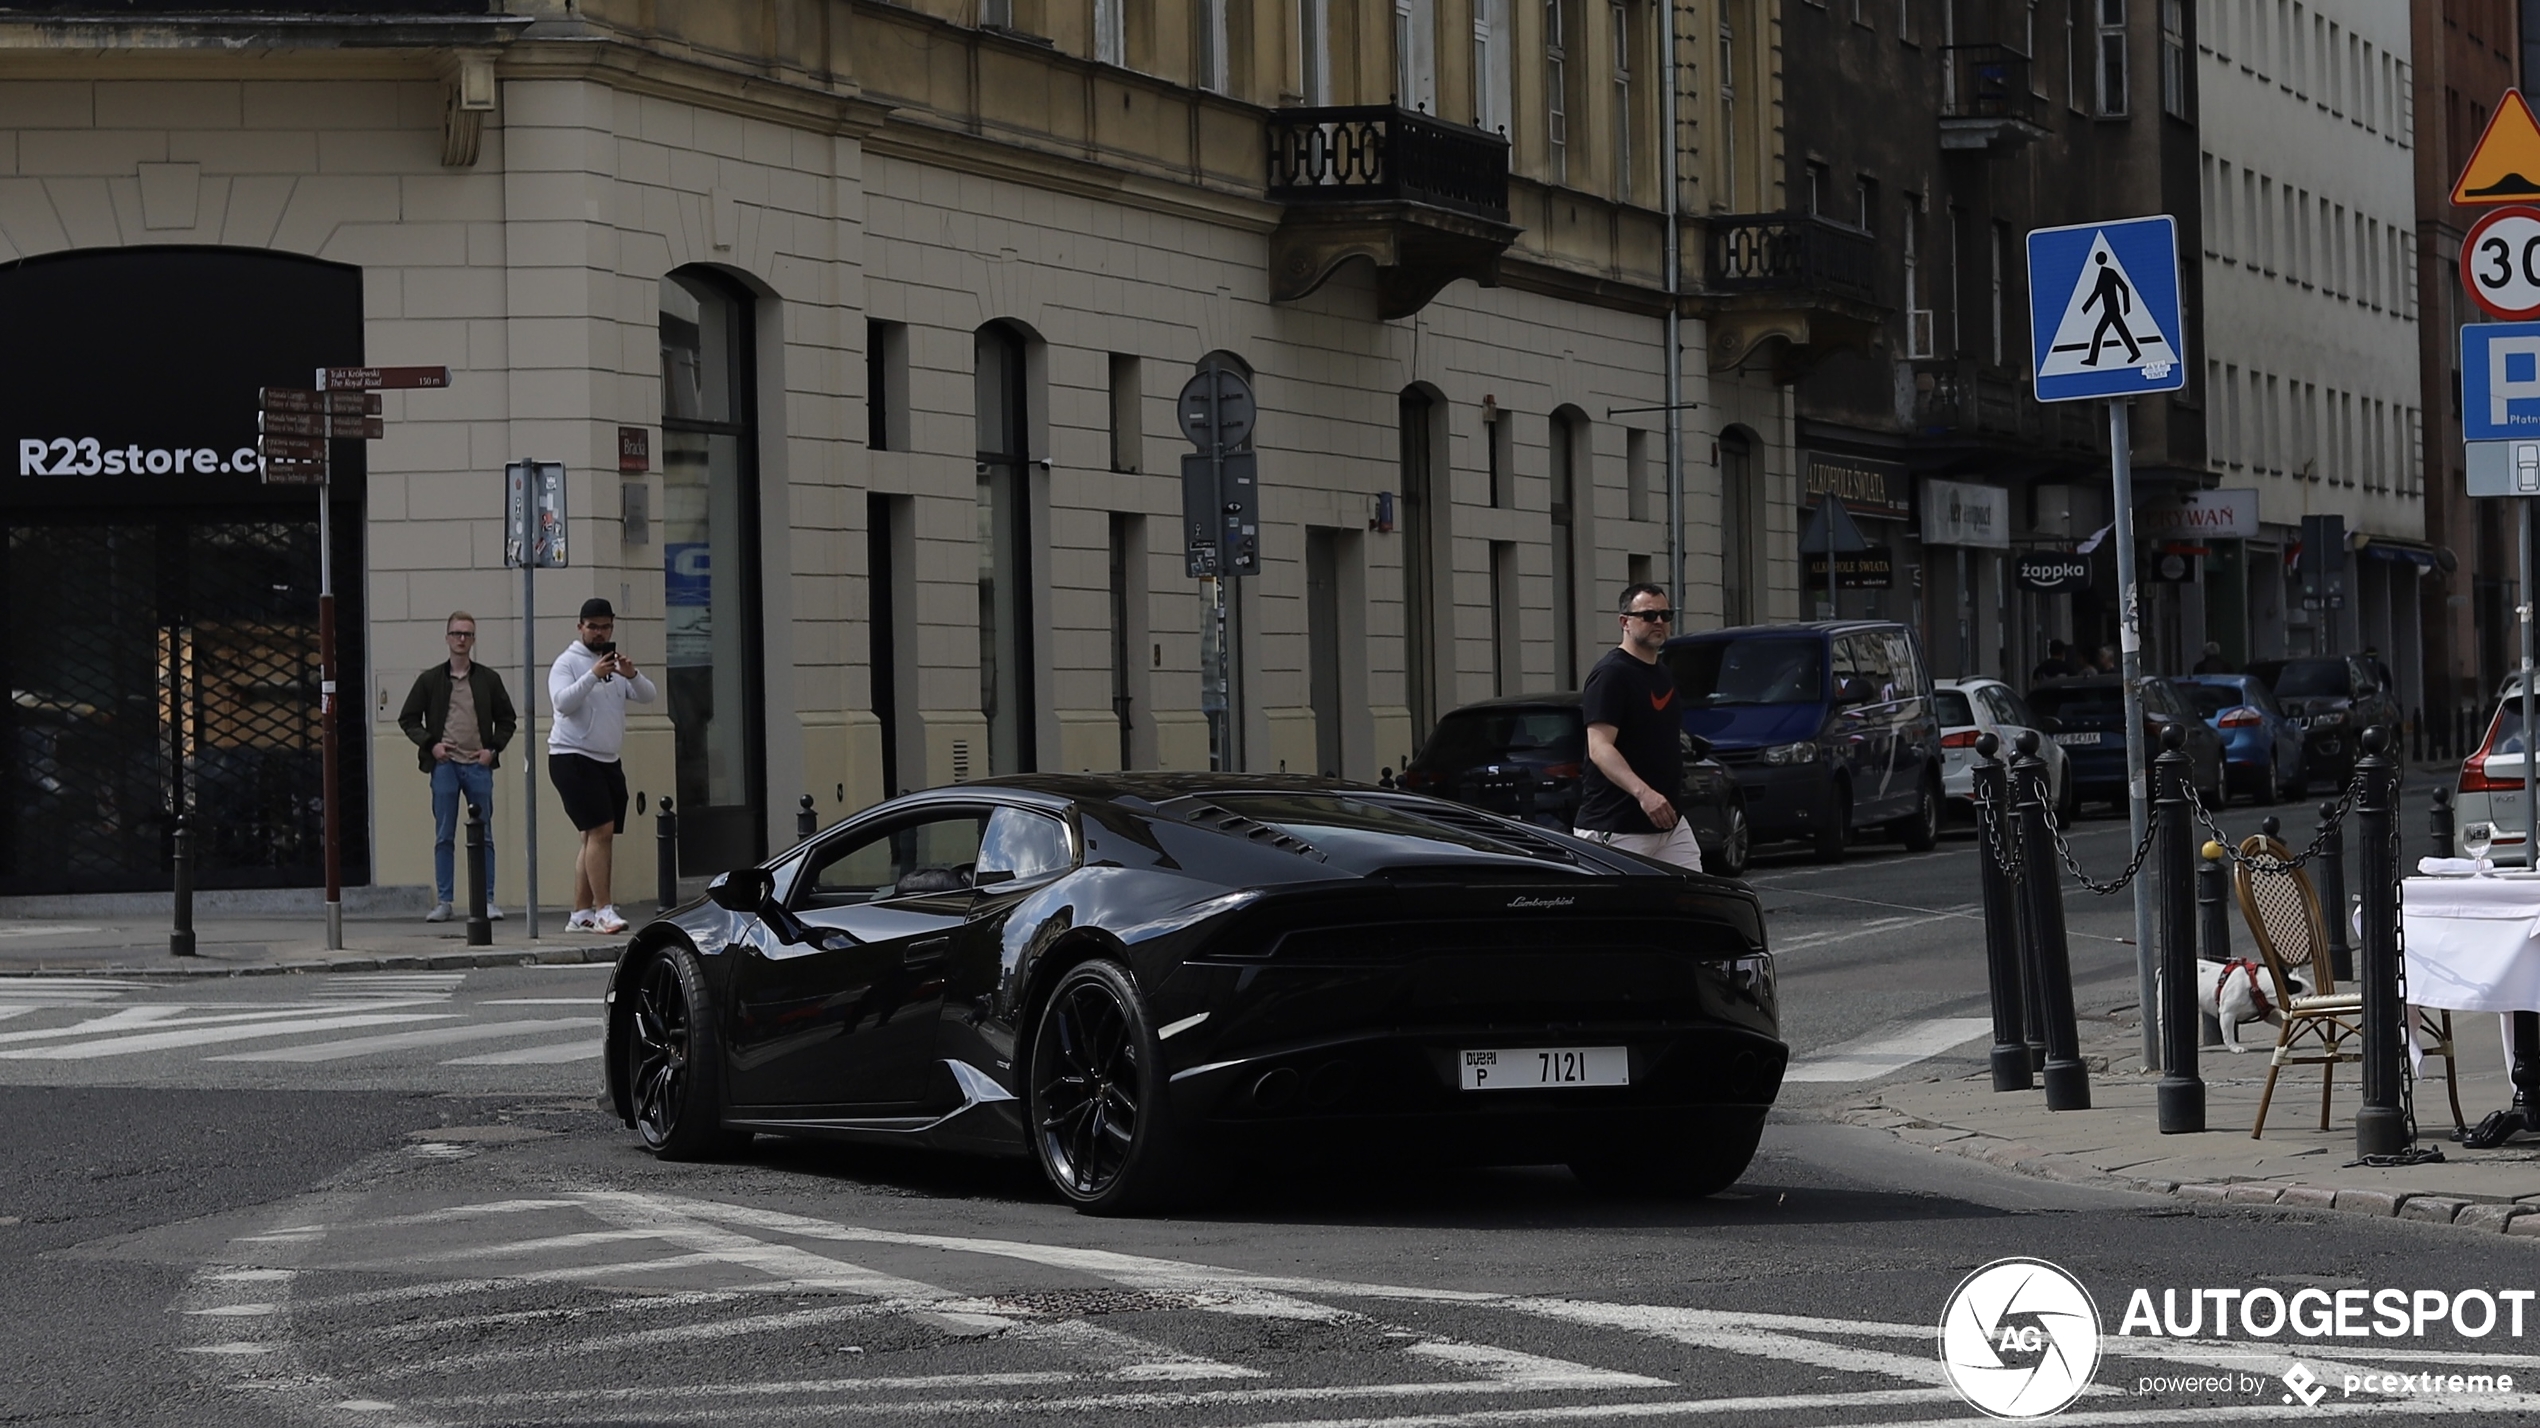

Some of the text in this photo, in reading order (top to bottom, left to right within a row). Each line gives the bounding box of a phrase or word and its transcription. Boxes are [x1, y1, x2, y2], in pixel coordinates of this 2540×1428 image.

[330, 368, 380, 379] Trakt Królewski
[2489, 335, 2540, 425] P
[330, 377, 382, 389] The Royal Road
[2510, 414, 2540, 425] Płatn
[19, 436, 322, 476] R23store.c
[1806, 462, 1886, 503] ALKOHOLE ŚWIATA
[1811, 560, 1856, 573] ALKHOLE
[2021, 562, 2084, 580] żappka
[1506, 896, 1575, 909] Lamborghini
[1465, 1052, 1497, 1066] DUBAI
[1538, 1052, 1586, 1083] 7121
[1476, 1068, 1488, 1087] P
